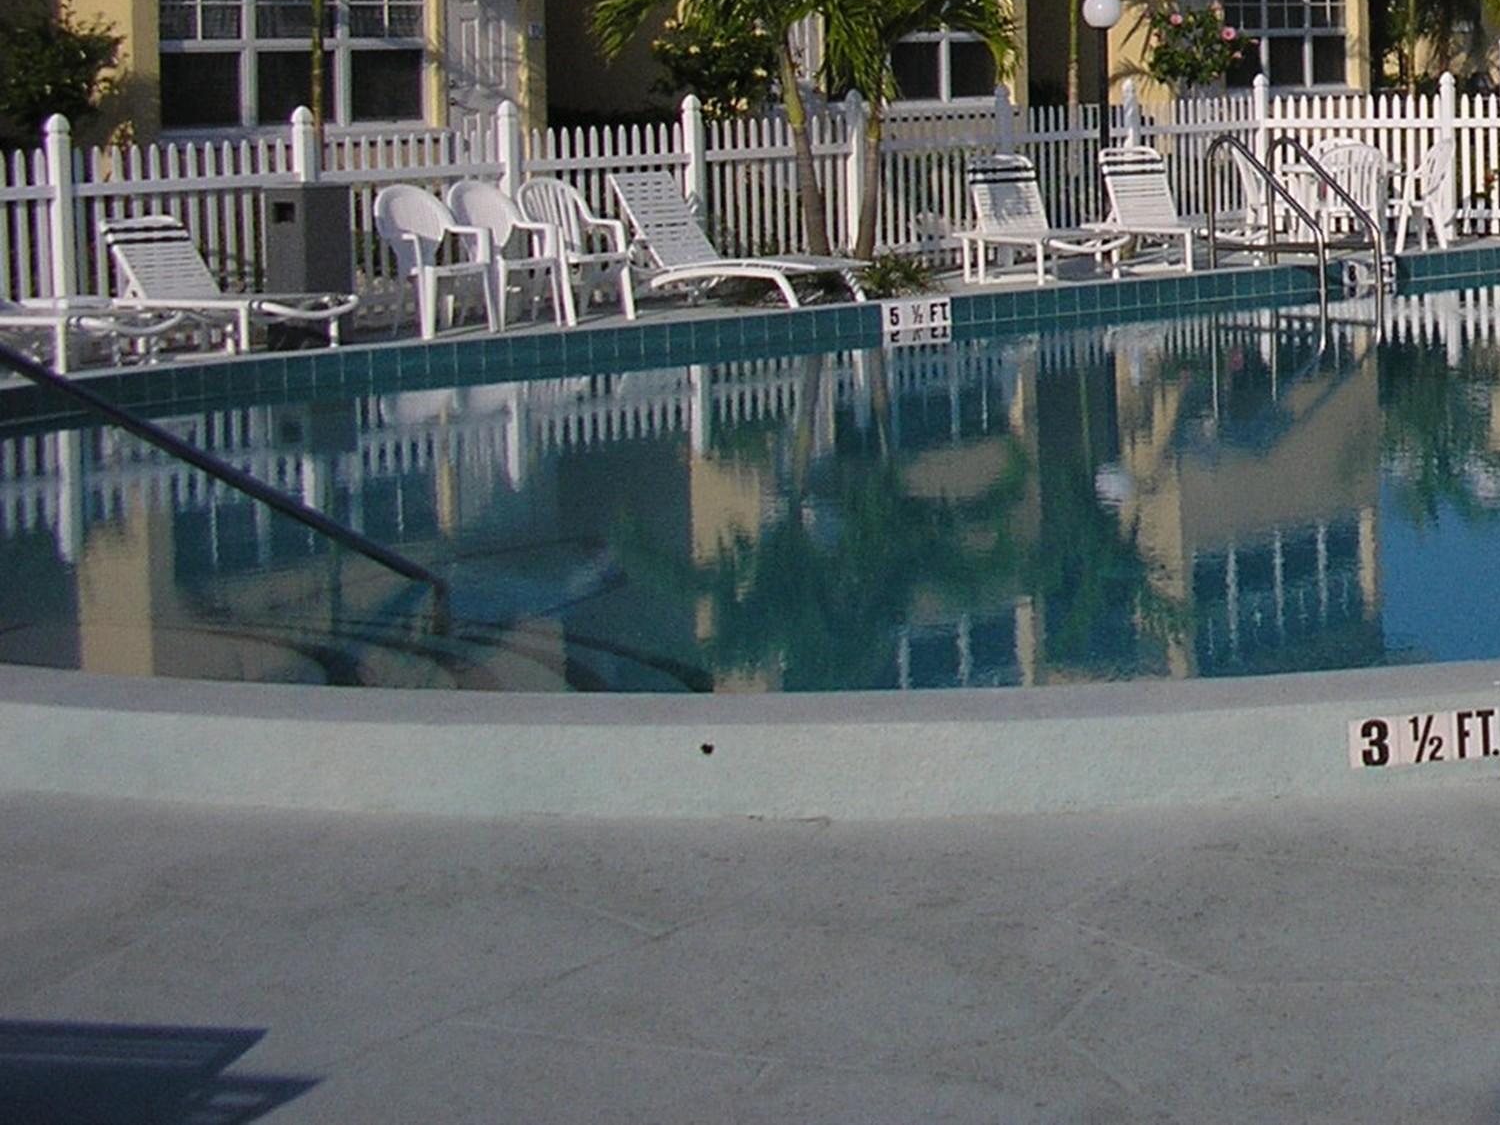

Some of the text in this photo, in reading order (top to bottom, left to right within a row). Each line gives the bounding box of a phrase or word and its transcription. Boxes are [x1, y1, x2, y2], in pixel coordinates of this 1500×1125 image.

[890, 306, 900, 326] 5
[1361, 719, 1389, 767] 3
[1457, 709, 1500, 759] FT.
